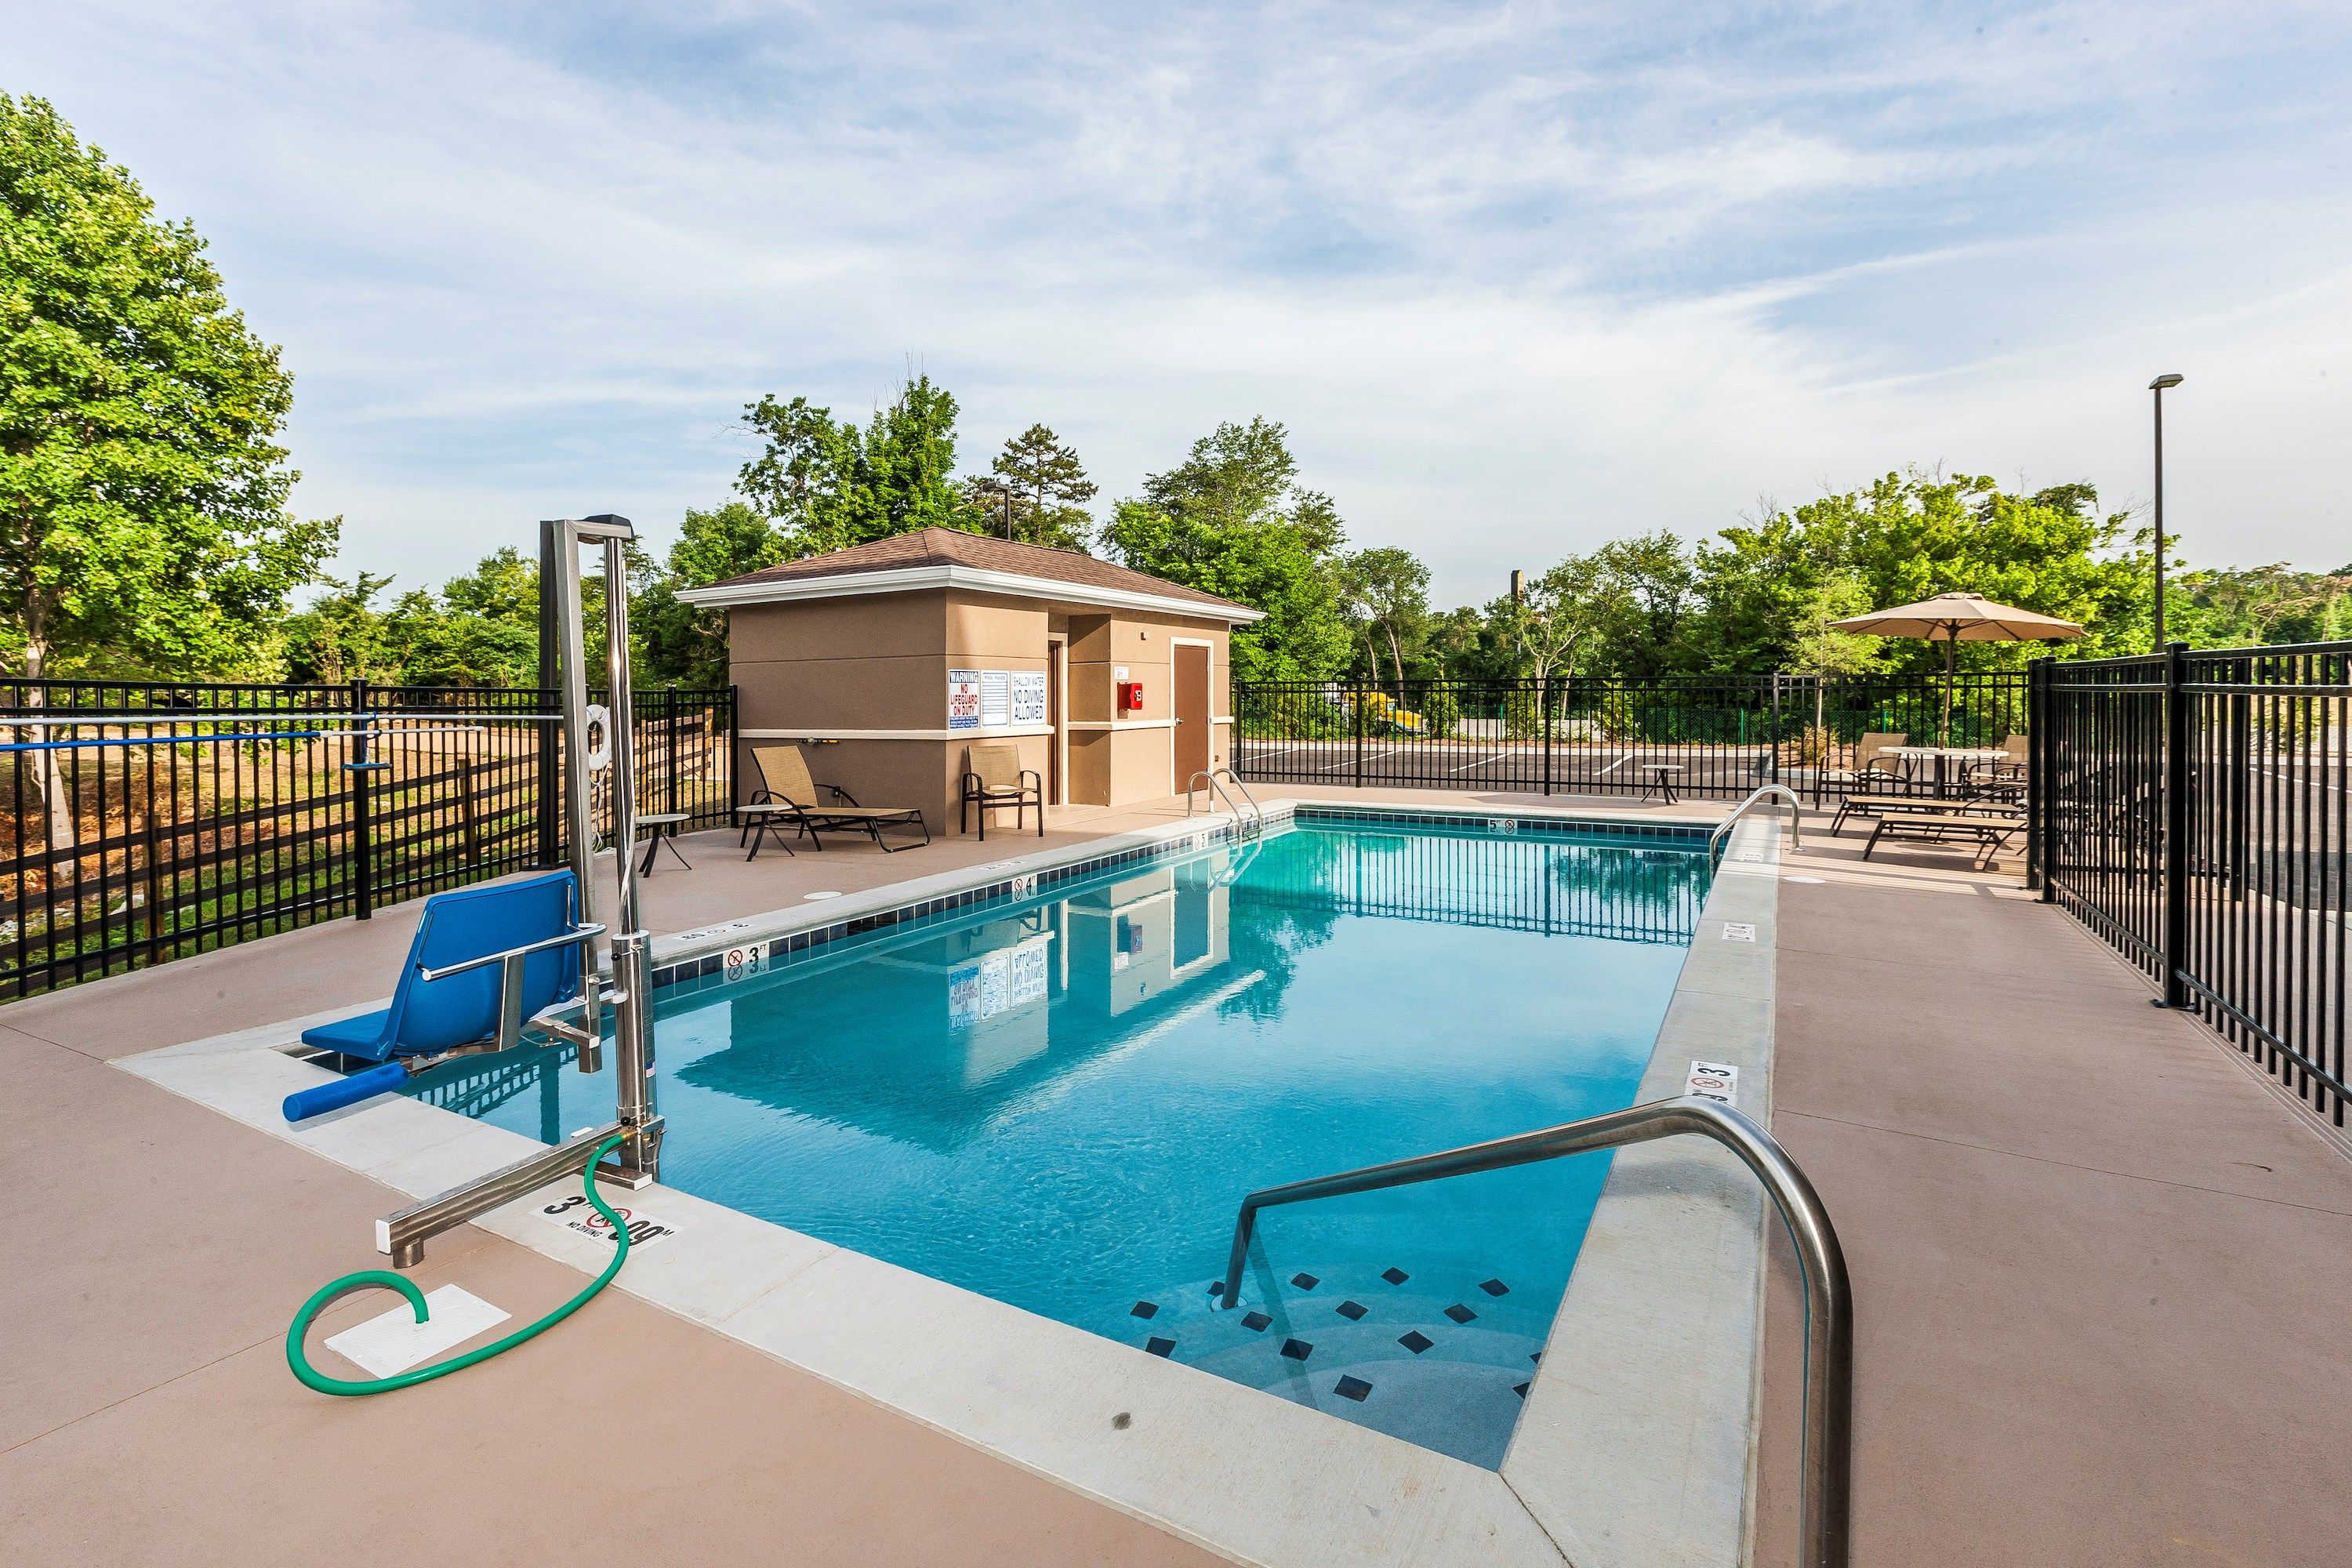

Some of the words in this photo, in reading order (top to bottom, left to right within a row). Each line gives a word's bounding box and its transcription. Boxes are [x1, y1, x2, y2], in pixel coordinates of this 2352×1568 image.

[950, 671, 978, 683] WARNING
[1014, 677, 1030, 687] SHALLOW
[1032, 677, 1044, 687] WATER
[960, 684, 968, 694] NO
[950, 695, 978, 705] LIFEGUARD
[1014, 689, 1022, 703] NO
[1024, 689, 1044, 703] DIVING
[953, 706, 960, 716] ON
[962, 705, 975, 716] DUTY
[1014, 706, 1044, 720] ALLOWED
[1026, 877, 1032, 887] 4
[749, 946, 759, 963] 3
[1697, 1068, 1730, 1076] 3
[543, 1196, 586, 1214] 3
[576, 1225, 604, 1237] DIVING
[662, 1229, 676, 1237] M
